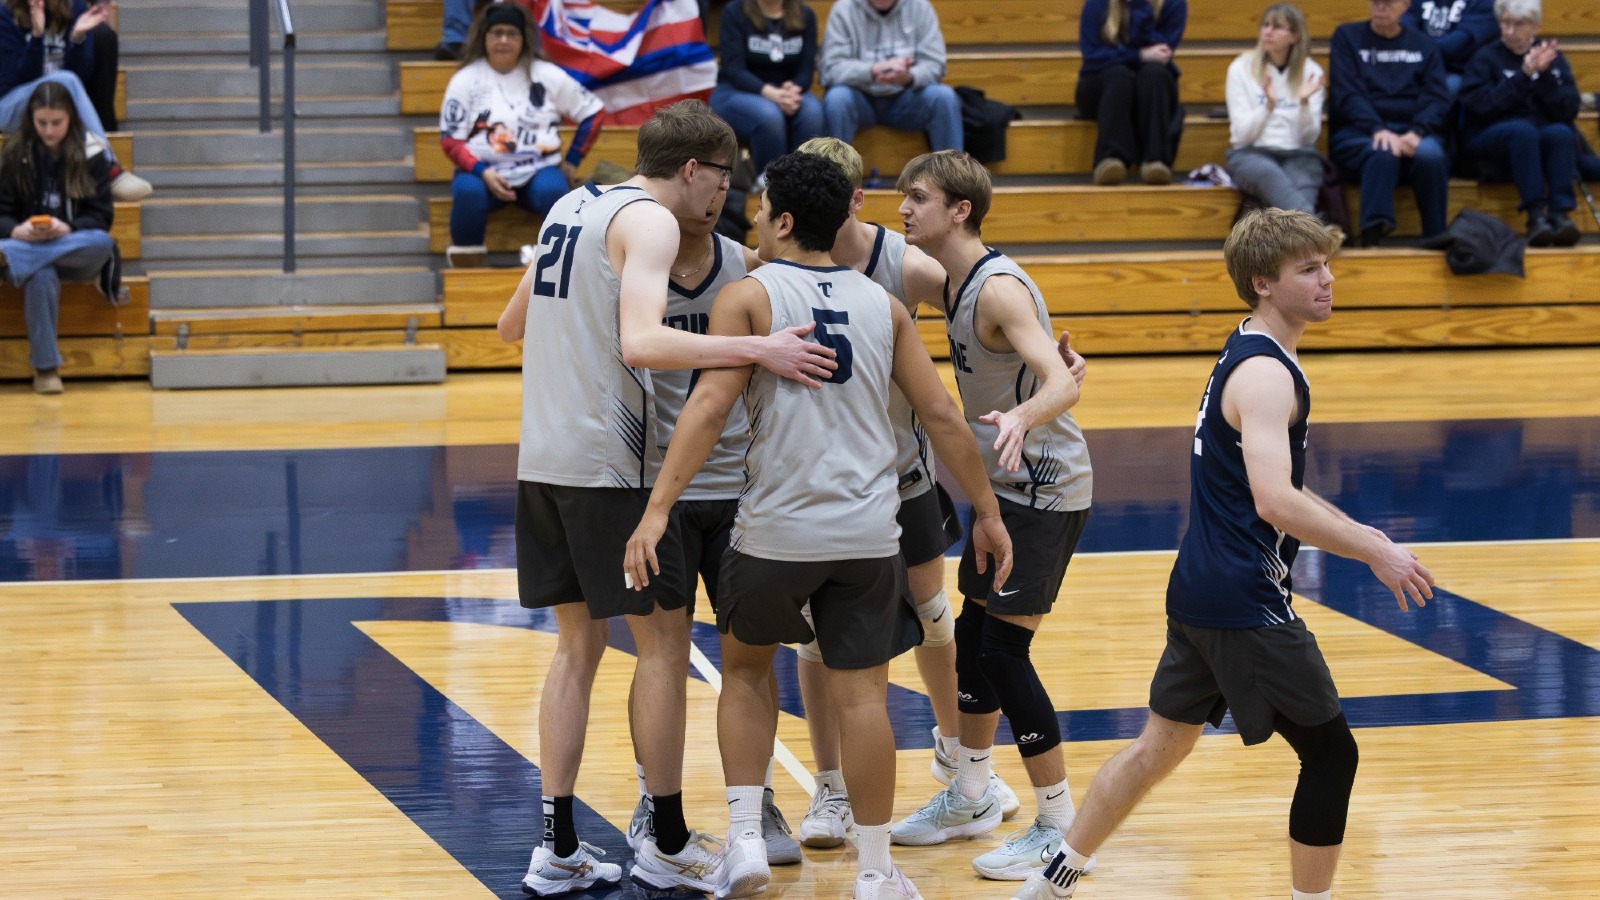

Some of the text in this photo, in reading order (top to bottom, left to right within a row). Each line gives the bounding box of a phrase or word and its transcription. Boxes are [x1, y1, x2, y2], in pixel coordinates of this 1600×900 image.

[533, 223, 583, 299] 21
[817, 282, 832, 298] T
[812, 307, 853, 385] 5
